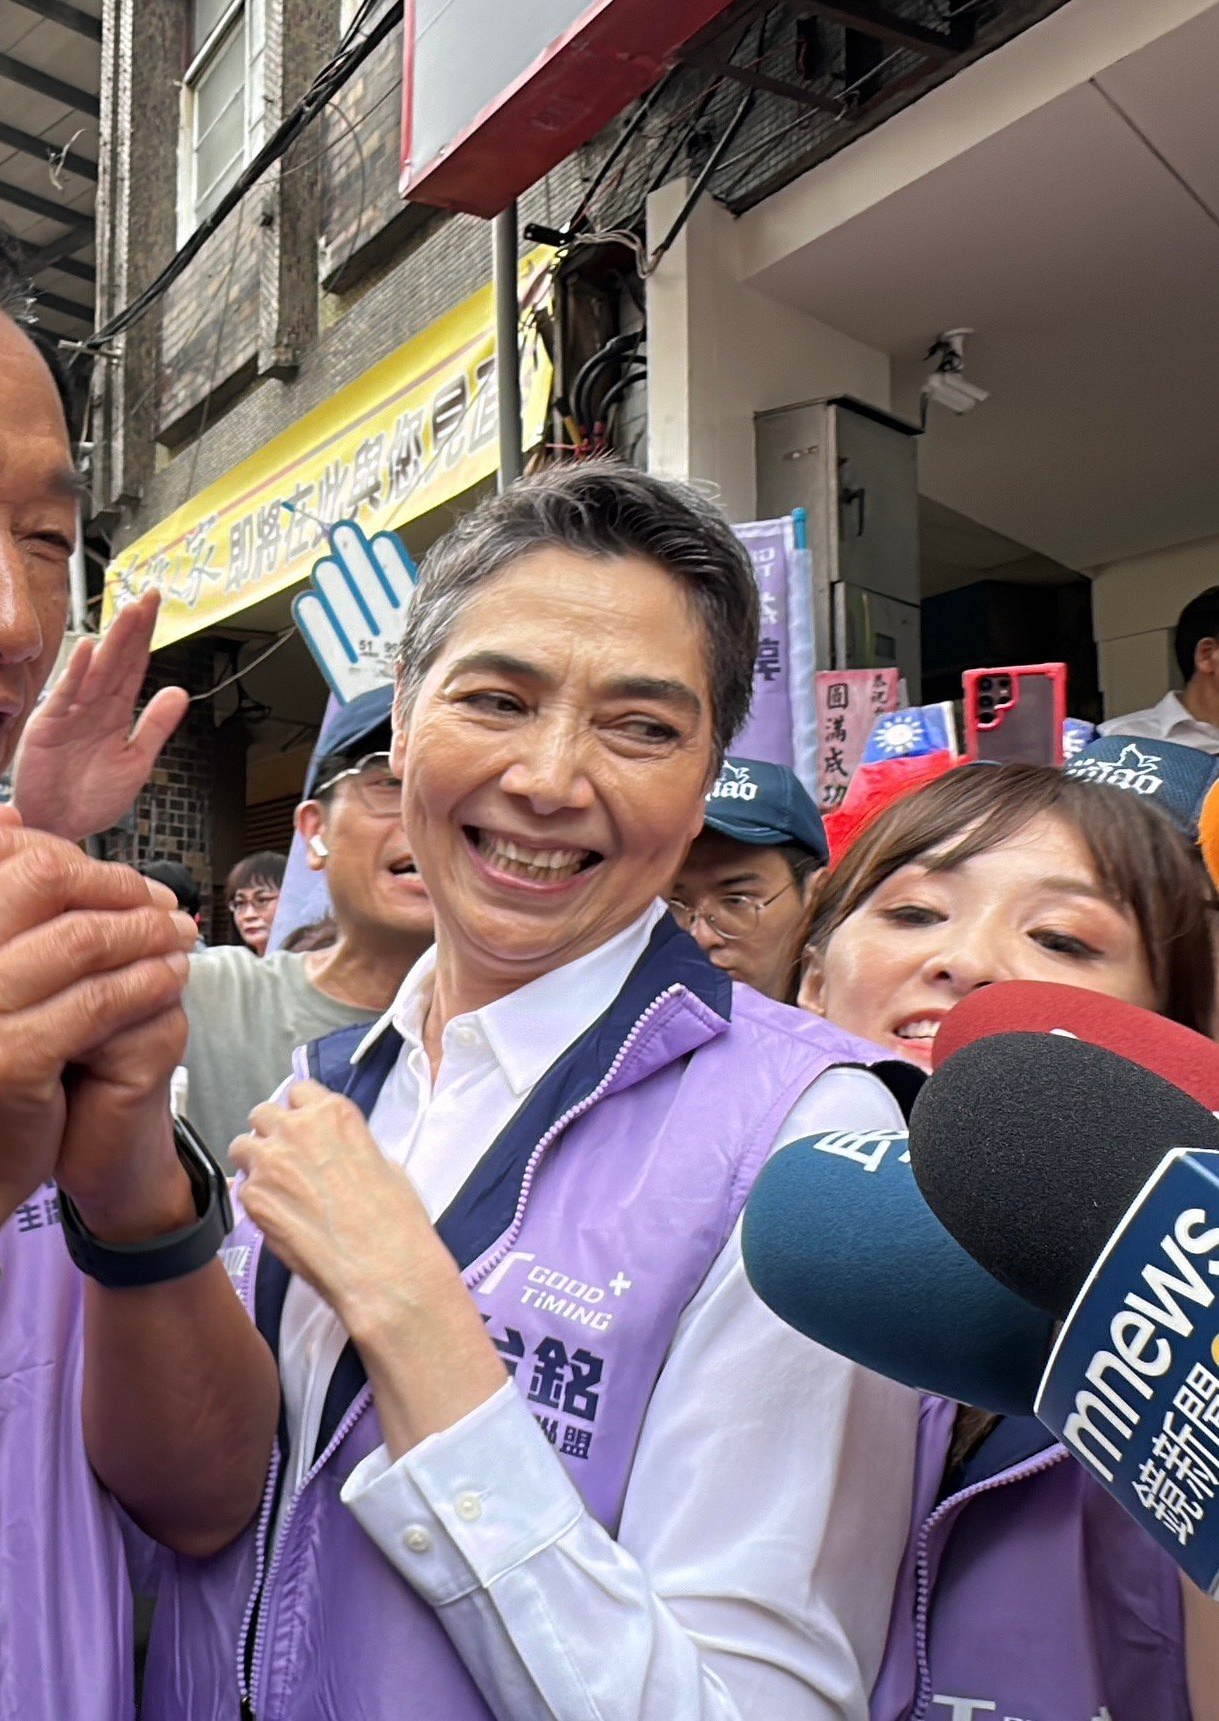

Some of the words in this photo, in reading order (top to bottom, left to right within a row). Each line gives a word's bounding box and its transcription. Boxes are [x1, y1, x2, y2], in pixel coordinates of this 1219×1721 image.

[823, 683, 849, 801] 圓滿成功
[527, 1265, 605, 1304] GOOD
[1063, 1208, 1219, 1483] mnews
[1132, 1362, 1219, 1546] 鏡新聞
